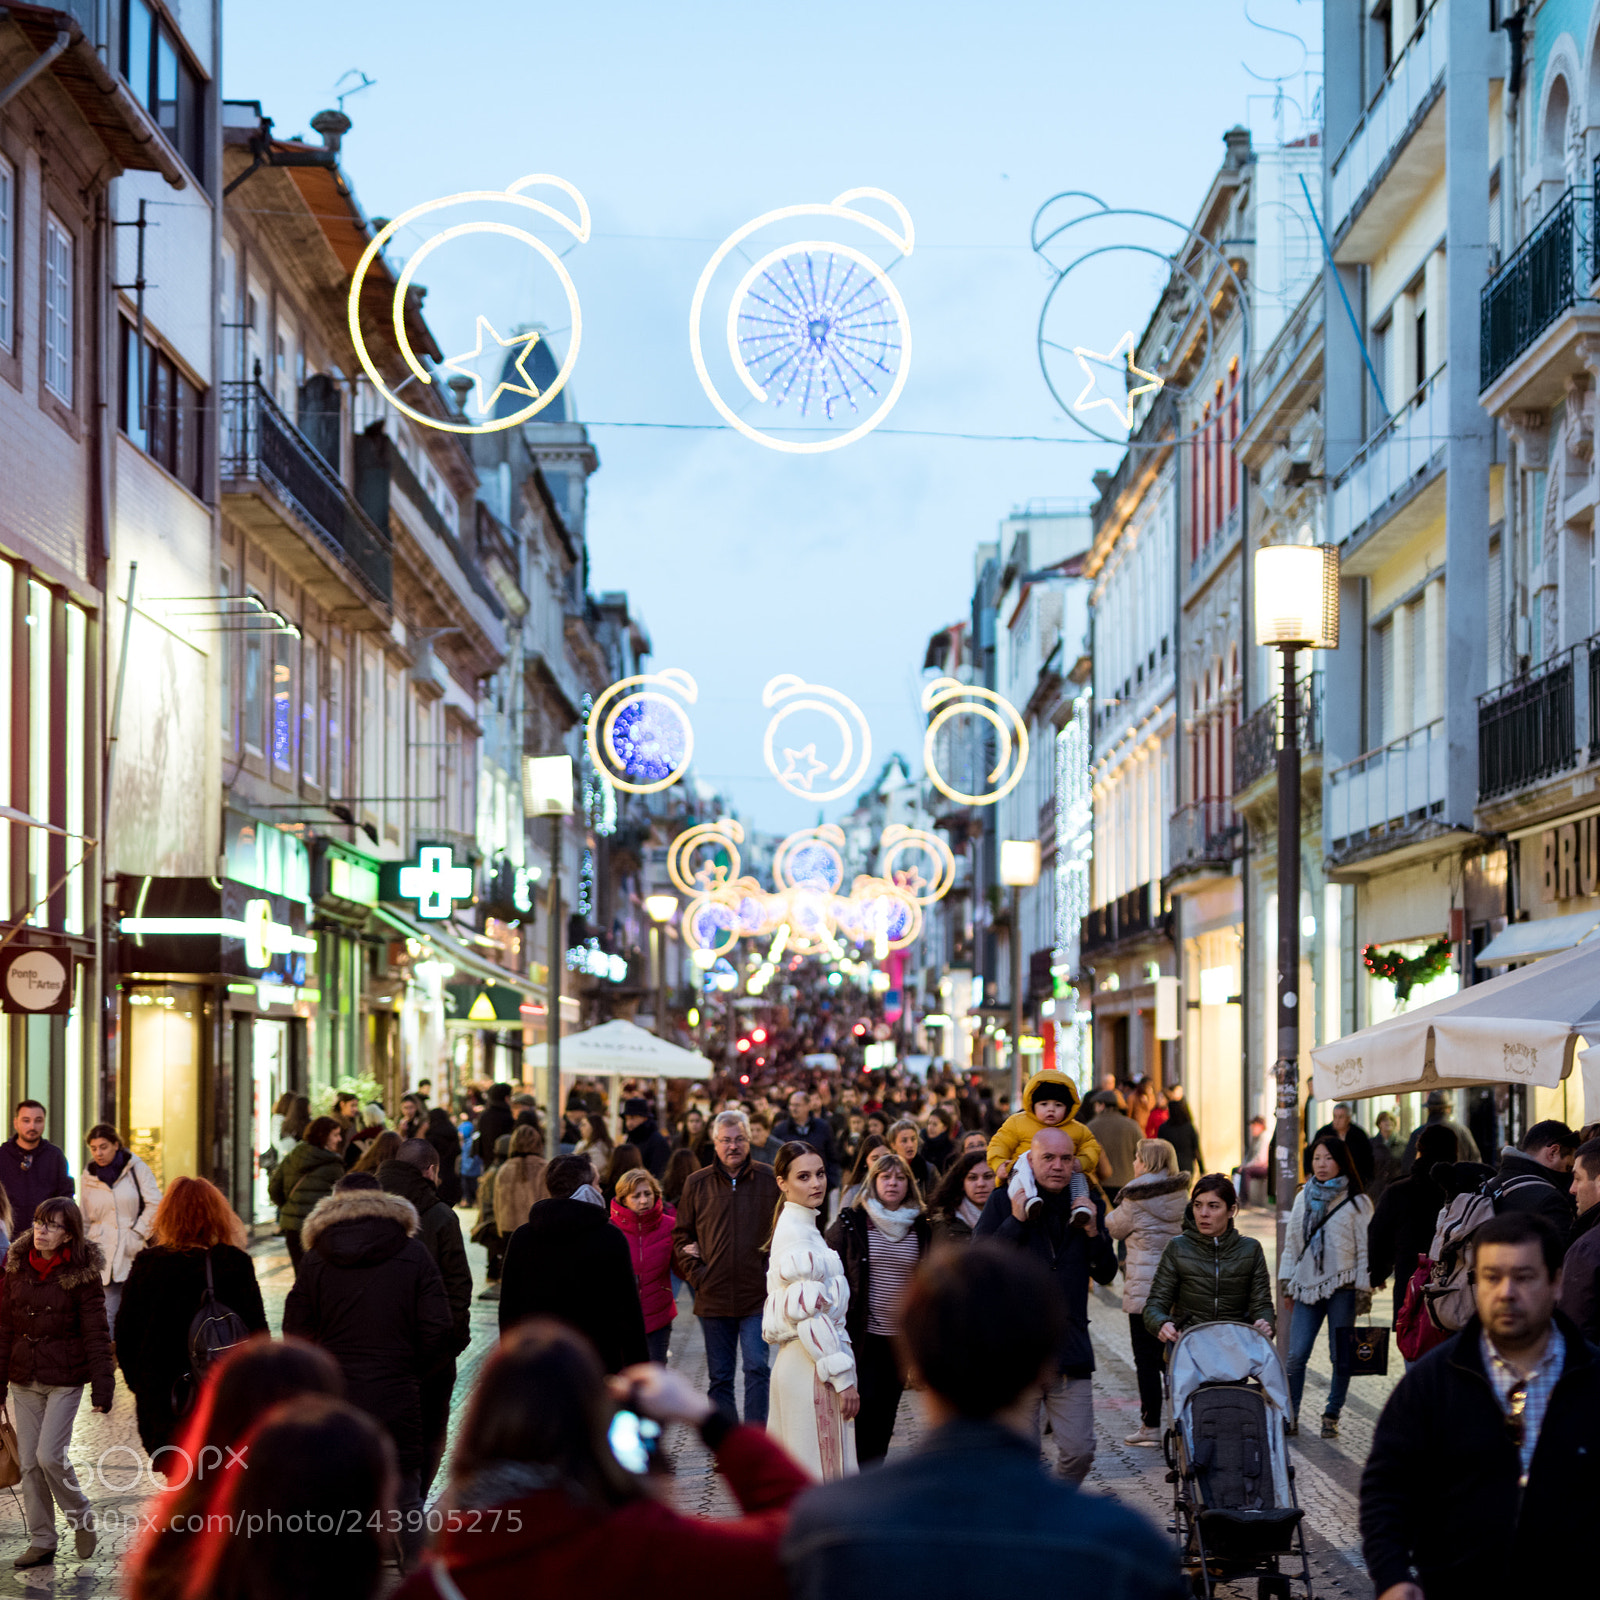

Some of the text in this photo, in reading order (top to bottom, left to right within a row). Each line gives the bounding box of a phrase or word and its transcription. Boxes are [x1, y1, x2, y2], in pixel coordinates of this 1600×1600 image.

[1540, 815, 1598, 904] BRU
[11, 968, 38, 984] Ponto
[36, 979, 61, 990] Artes
